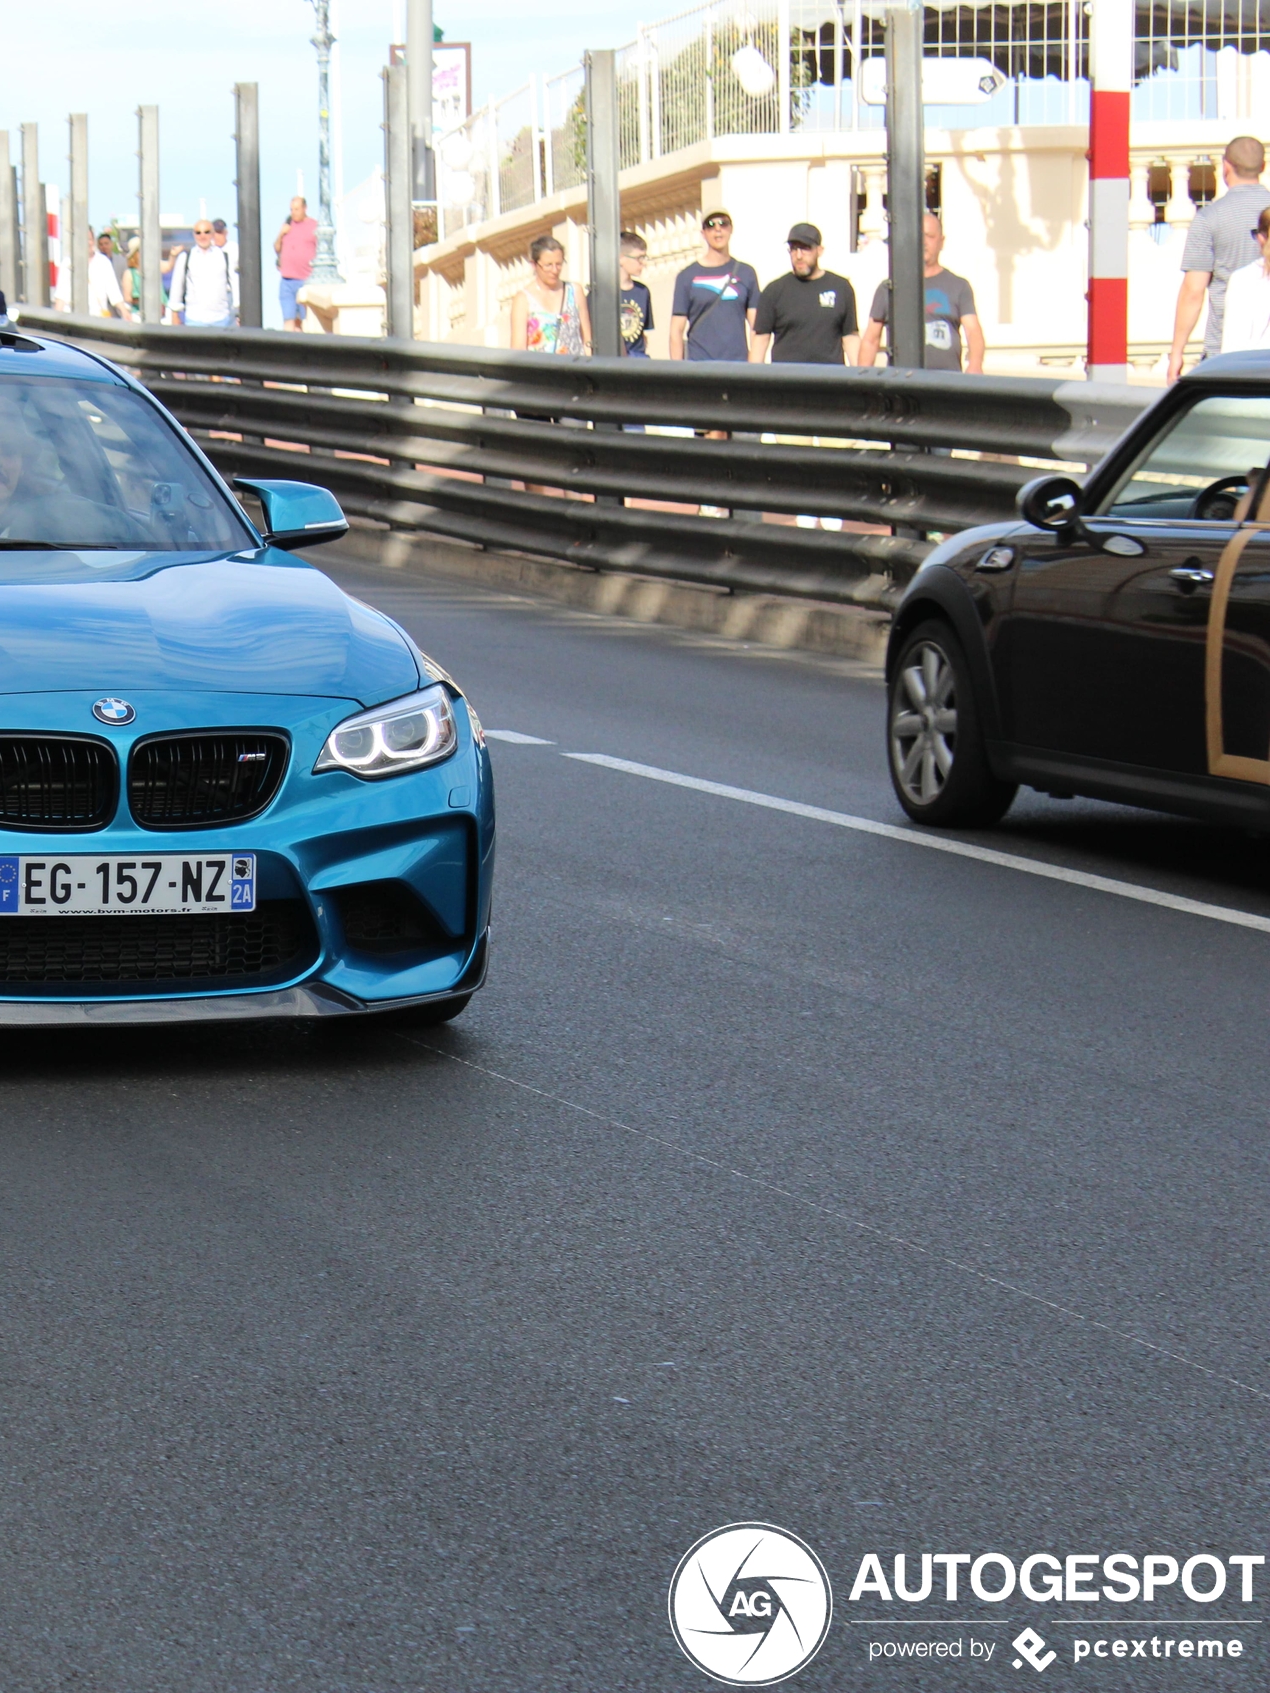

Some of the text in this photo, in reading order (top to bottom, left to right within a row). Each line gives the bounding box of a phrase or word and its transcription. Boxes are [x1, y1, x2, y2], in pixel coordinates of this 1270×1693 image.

[24, 861, 226, 905] EG-157-NZ
[2, 889, 11, 902] F
[232, 884, 252, 904] 2A
